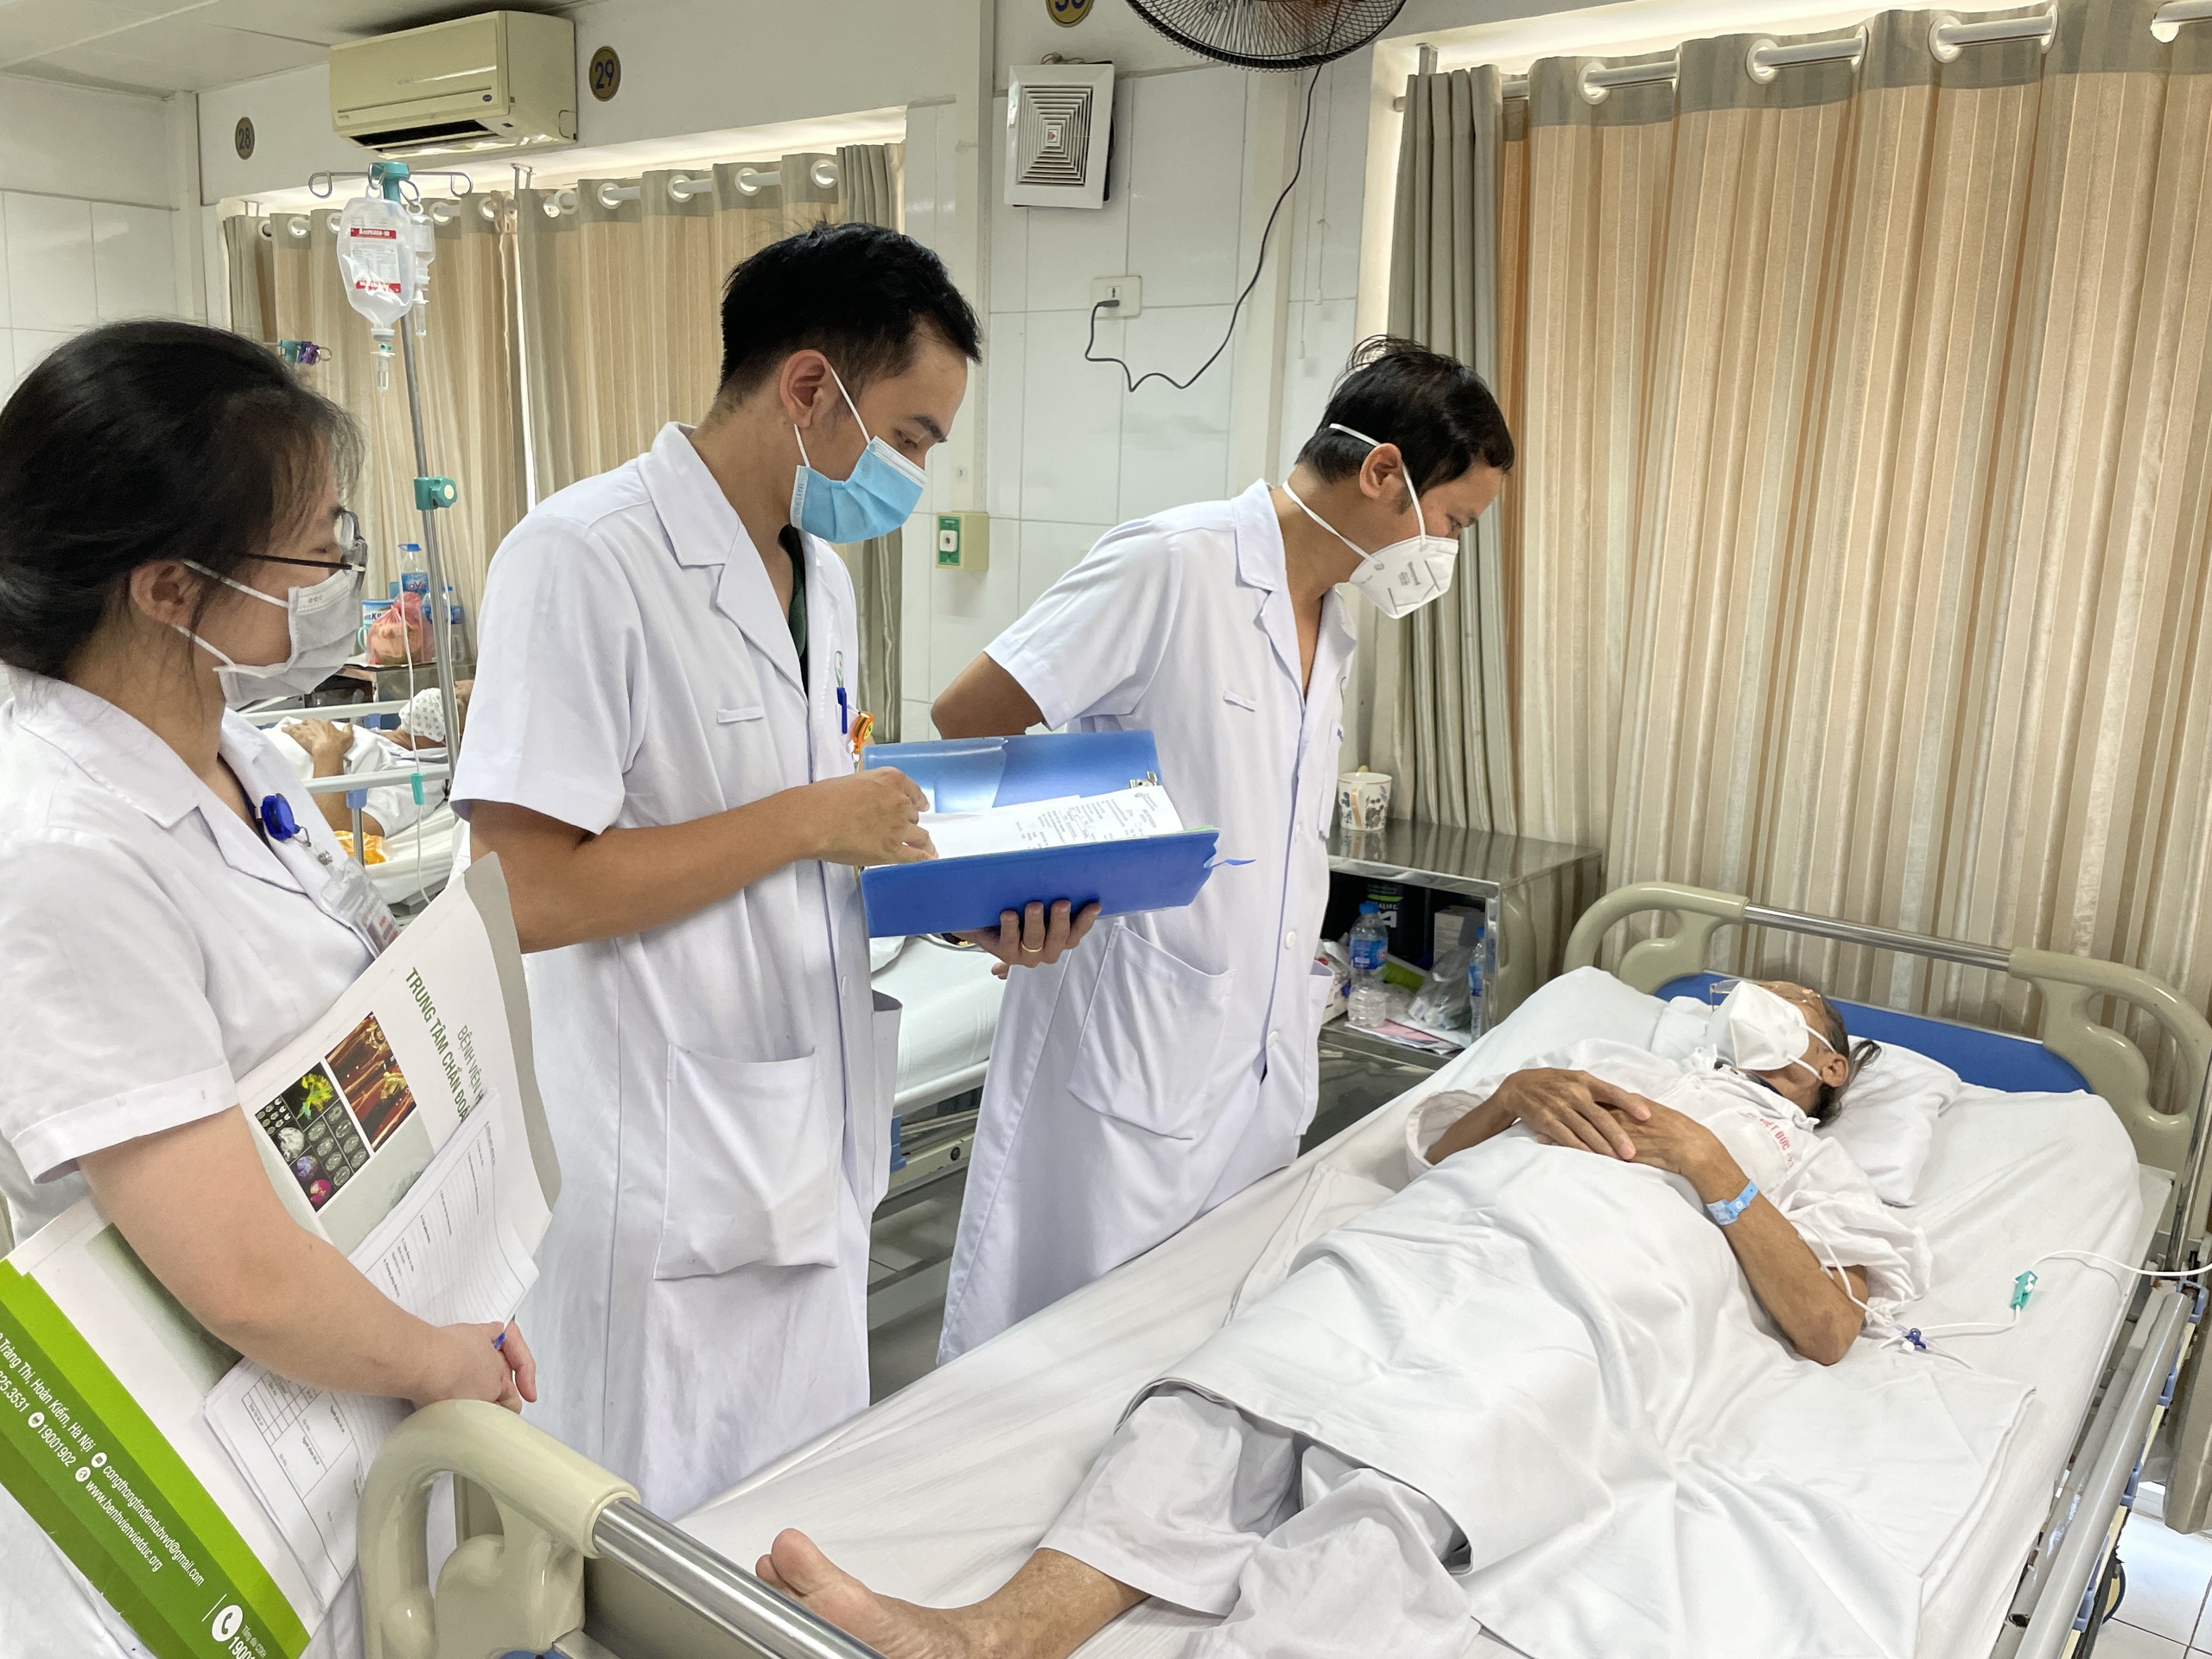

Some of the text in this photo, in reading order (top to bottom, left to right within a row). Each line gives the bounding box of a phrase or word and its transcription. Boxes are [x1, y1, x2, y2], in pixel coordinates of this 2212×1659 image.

[594, 59, 614, 89] 29
[238, 127, 251, 150] 28
[405, 967, 436, 1023] TRUNG
[429, 1018, 449, 1055] TÂM
[442, 1052, 462, 1094] CHẨN
[457, 1025, 475, 1066] BỆNH
[468, 1061, 483, 1095] VIỆN
[30, 1378, 53, 1404] Hoàn
[48, 1399, 71, 1428] Kiếm,
[67, 1422, 83, 1439] Hà
[77, 1433, 97, 1452] Nội
[37, 1424, 76, 1467] 19001902
[85, 1480, 162, 1573] www.benhvienvietduc.org
